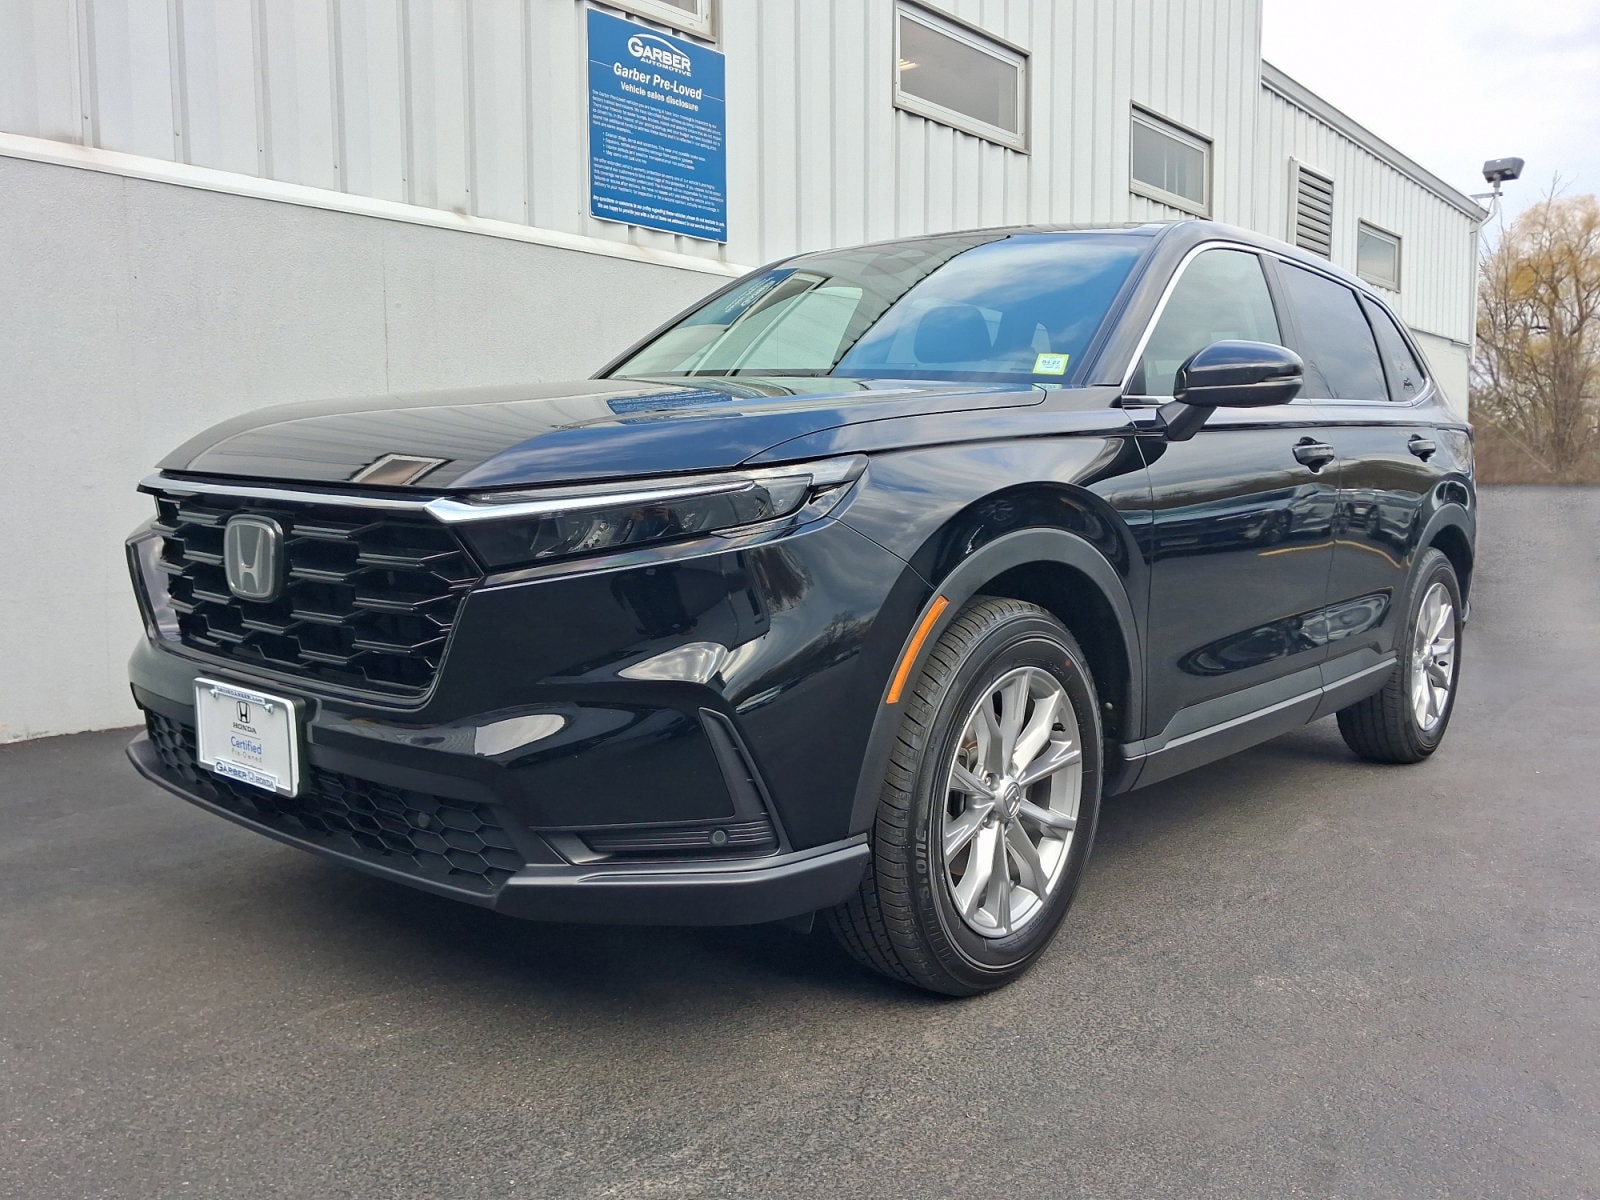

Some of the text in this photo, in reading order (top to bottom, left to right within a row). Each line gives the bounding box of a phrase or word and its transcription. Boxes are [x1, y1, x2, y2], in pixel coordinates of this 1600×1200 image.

[628, 37, 692, 72] GARBER
[640, 58, 692, 77] AUTOMOTIVE
[613, 62, 702, 100] Garber Pre-Loved
[621, 81, 699, 112] Vehicle sales disclosure
[232, 721, 257, 734] HONDA
[230, 736, 262, 755] Certified
[215, 761, 247, 778] GARBER
[255, 776, 275, 789] HONDA
